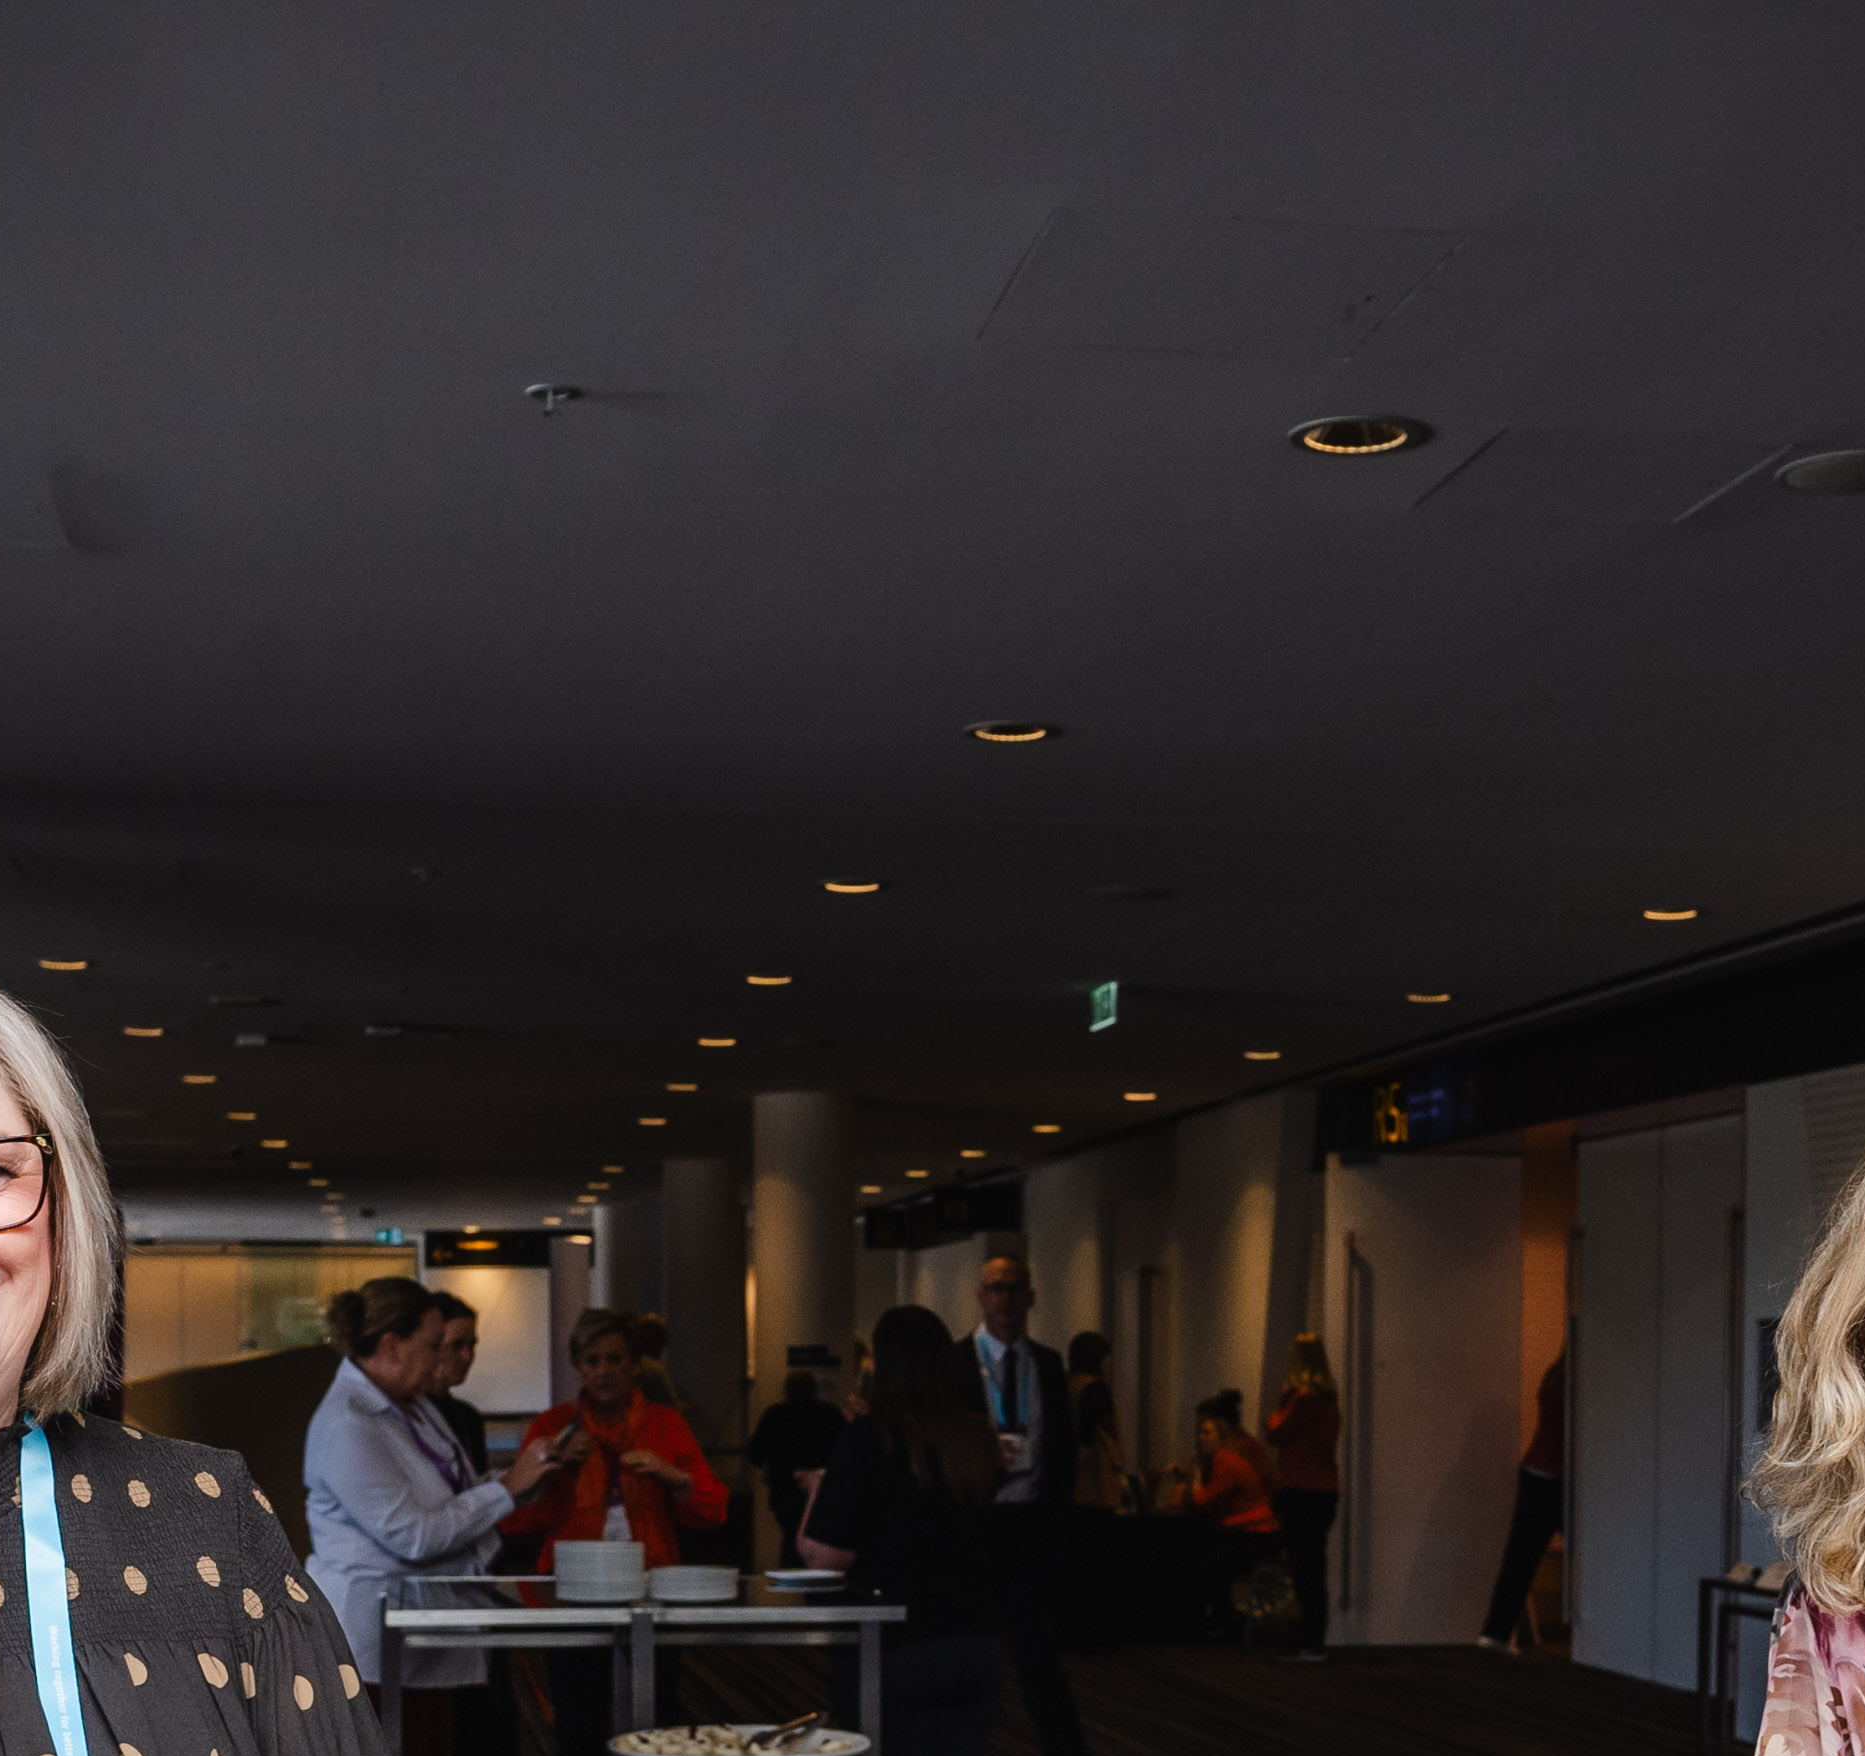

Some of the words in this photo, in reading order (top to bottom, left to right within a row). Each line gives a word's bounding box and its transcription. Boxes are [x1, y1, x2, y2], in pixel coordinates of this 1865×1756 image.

[49, 1625, 61, 1668] Working
[53, 1670, 66, 1714] together
[60, 1716, 70, 1729] for
